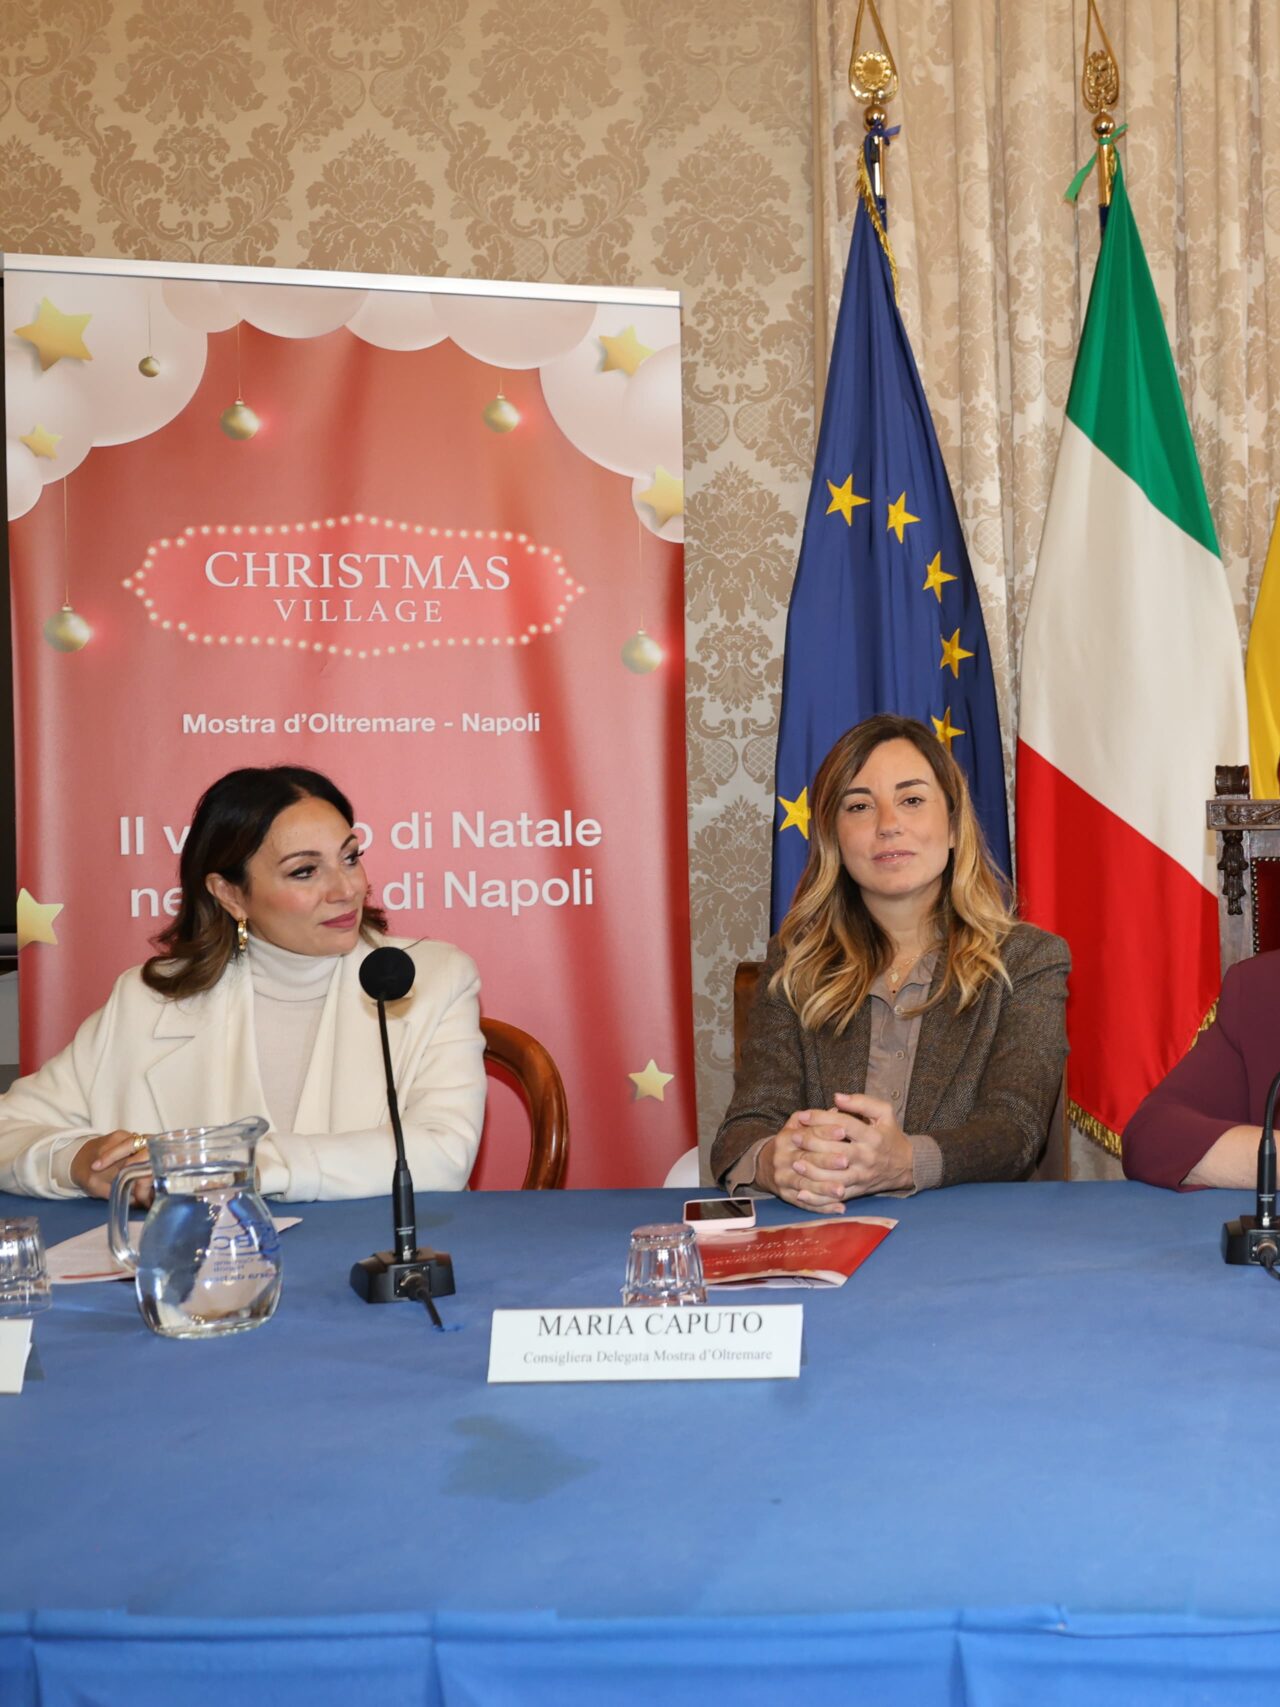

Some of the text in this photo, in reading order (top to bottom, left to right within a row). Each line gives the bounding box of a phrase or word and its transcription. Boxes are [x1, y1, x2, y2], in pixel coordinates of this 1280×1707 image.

[205, 551, 510, 590] CHRISTMAS
[274, 599, 443, 623] VILLAGE
[182, 713, 276, 734] Mostra
[461, 712, 541, 736] Napoli
[120, 816, 144, 855] Il
[390, 812, 433, 850] di
[452, 810, 603, 849] Natale
[382, 872, 426, 910] di
[444, 868, 595, 916] Napoli
[537, 1311, 763, 1337] MARIA CAPUTO
[523, 1350, 593, 1367] Consigliera
[596, 1349, 650, 1366] Delegata
[653, 1349, 696, 1362] Mostra
